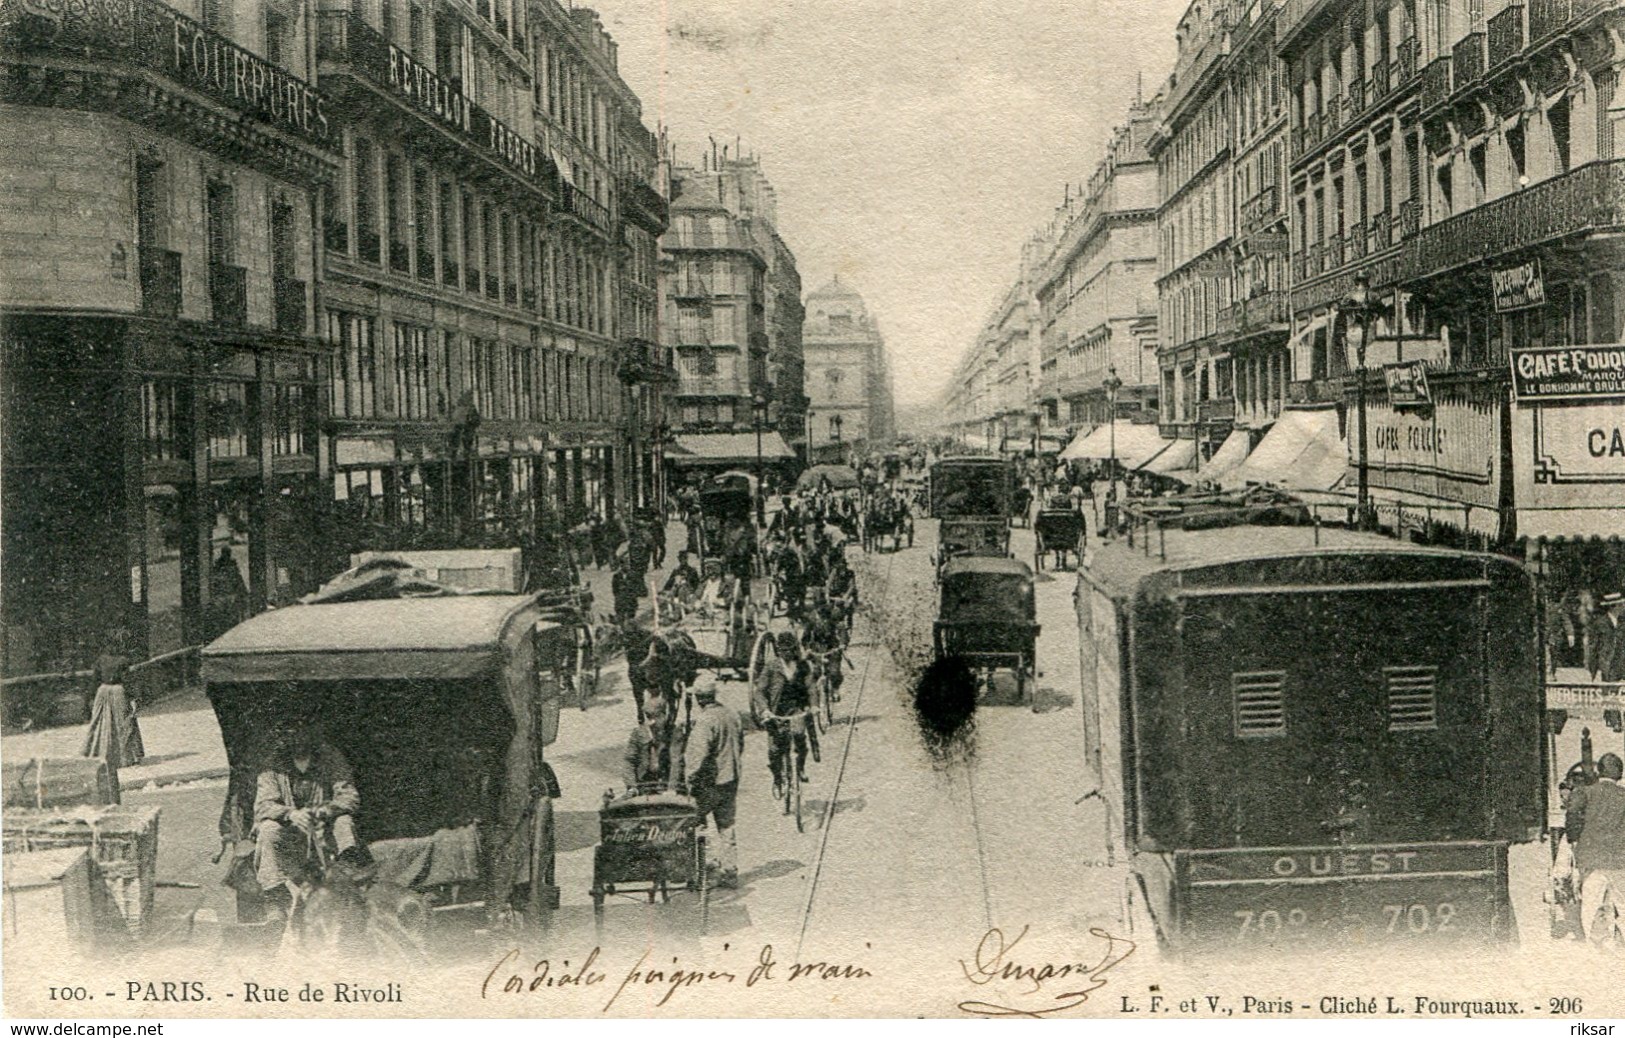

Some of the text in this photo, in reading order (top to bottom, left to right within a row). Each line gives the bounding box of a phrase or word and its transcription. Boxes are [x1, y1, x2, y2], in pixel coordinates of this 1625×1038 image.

[175, 20, 328, 139] FOURRURES
[389, 45, 471, 132] REVILLON
[1526, 385, 1536, 394] LE
[1539, 382, 1591, 394] BONHOMME
[1274, 851, 1416, 876] OUEST
[746, 944, 777, 988] de
[787, 942, 873, 981] main
[126, 981, 213, 1003] PARIS.
[244, 983, 290, 1002] Rue
[298, 983, 325, 1003] de
[334, 983, 403, 1003] Rivoli
[1120, 996, 1140, 1012] L.
[1149, 996, 1169, 1012] F.
[1180, 998, 1197, 1013] et
[1206, 996, 1233, 1015] V.,
[1242, 996, 1293, 1013] Paris
[1319, 995, 1377, 1013] Cliché
[1386, 997, 1405, 1013] L.
[1414, 996, 1524, 1018] Fourquaux.
[1549, 997, 1583, 1014] 206
